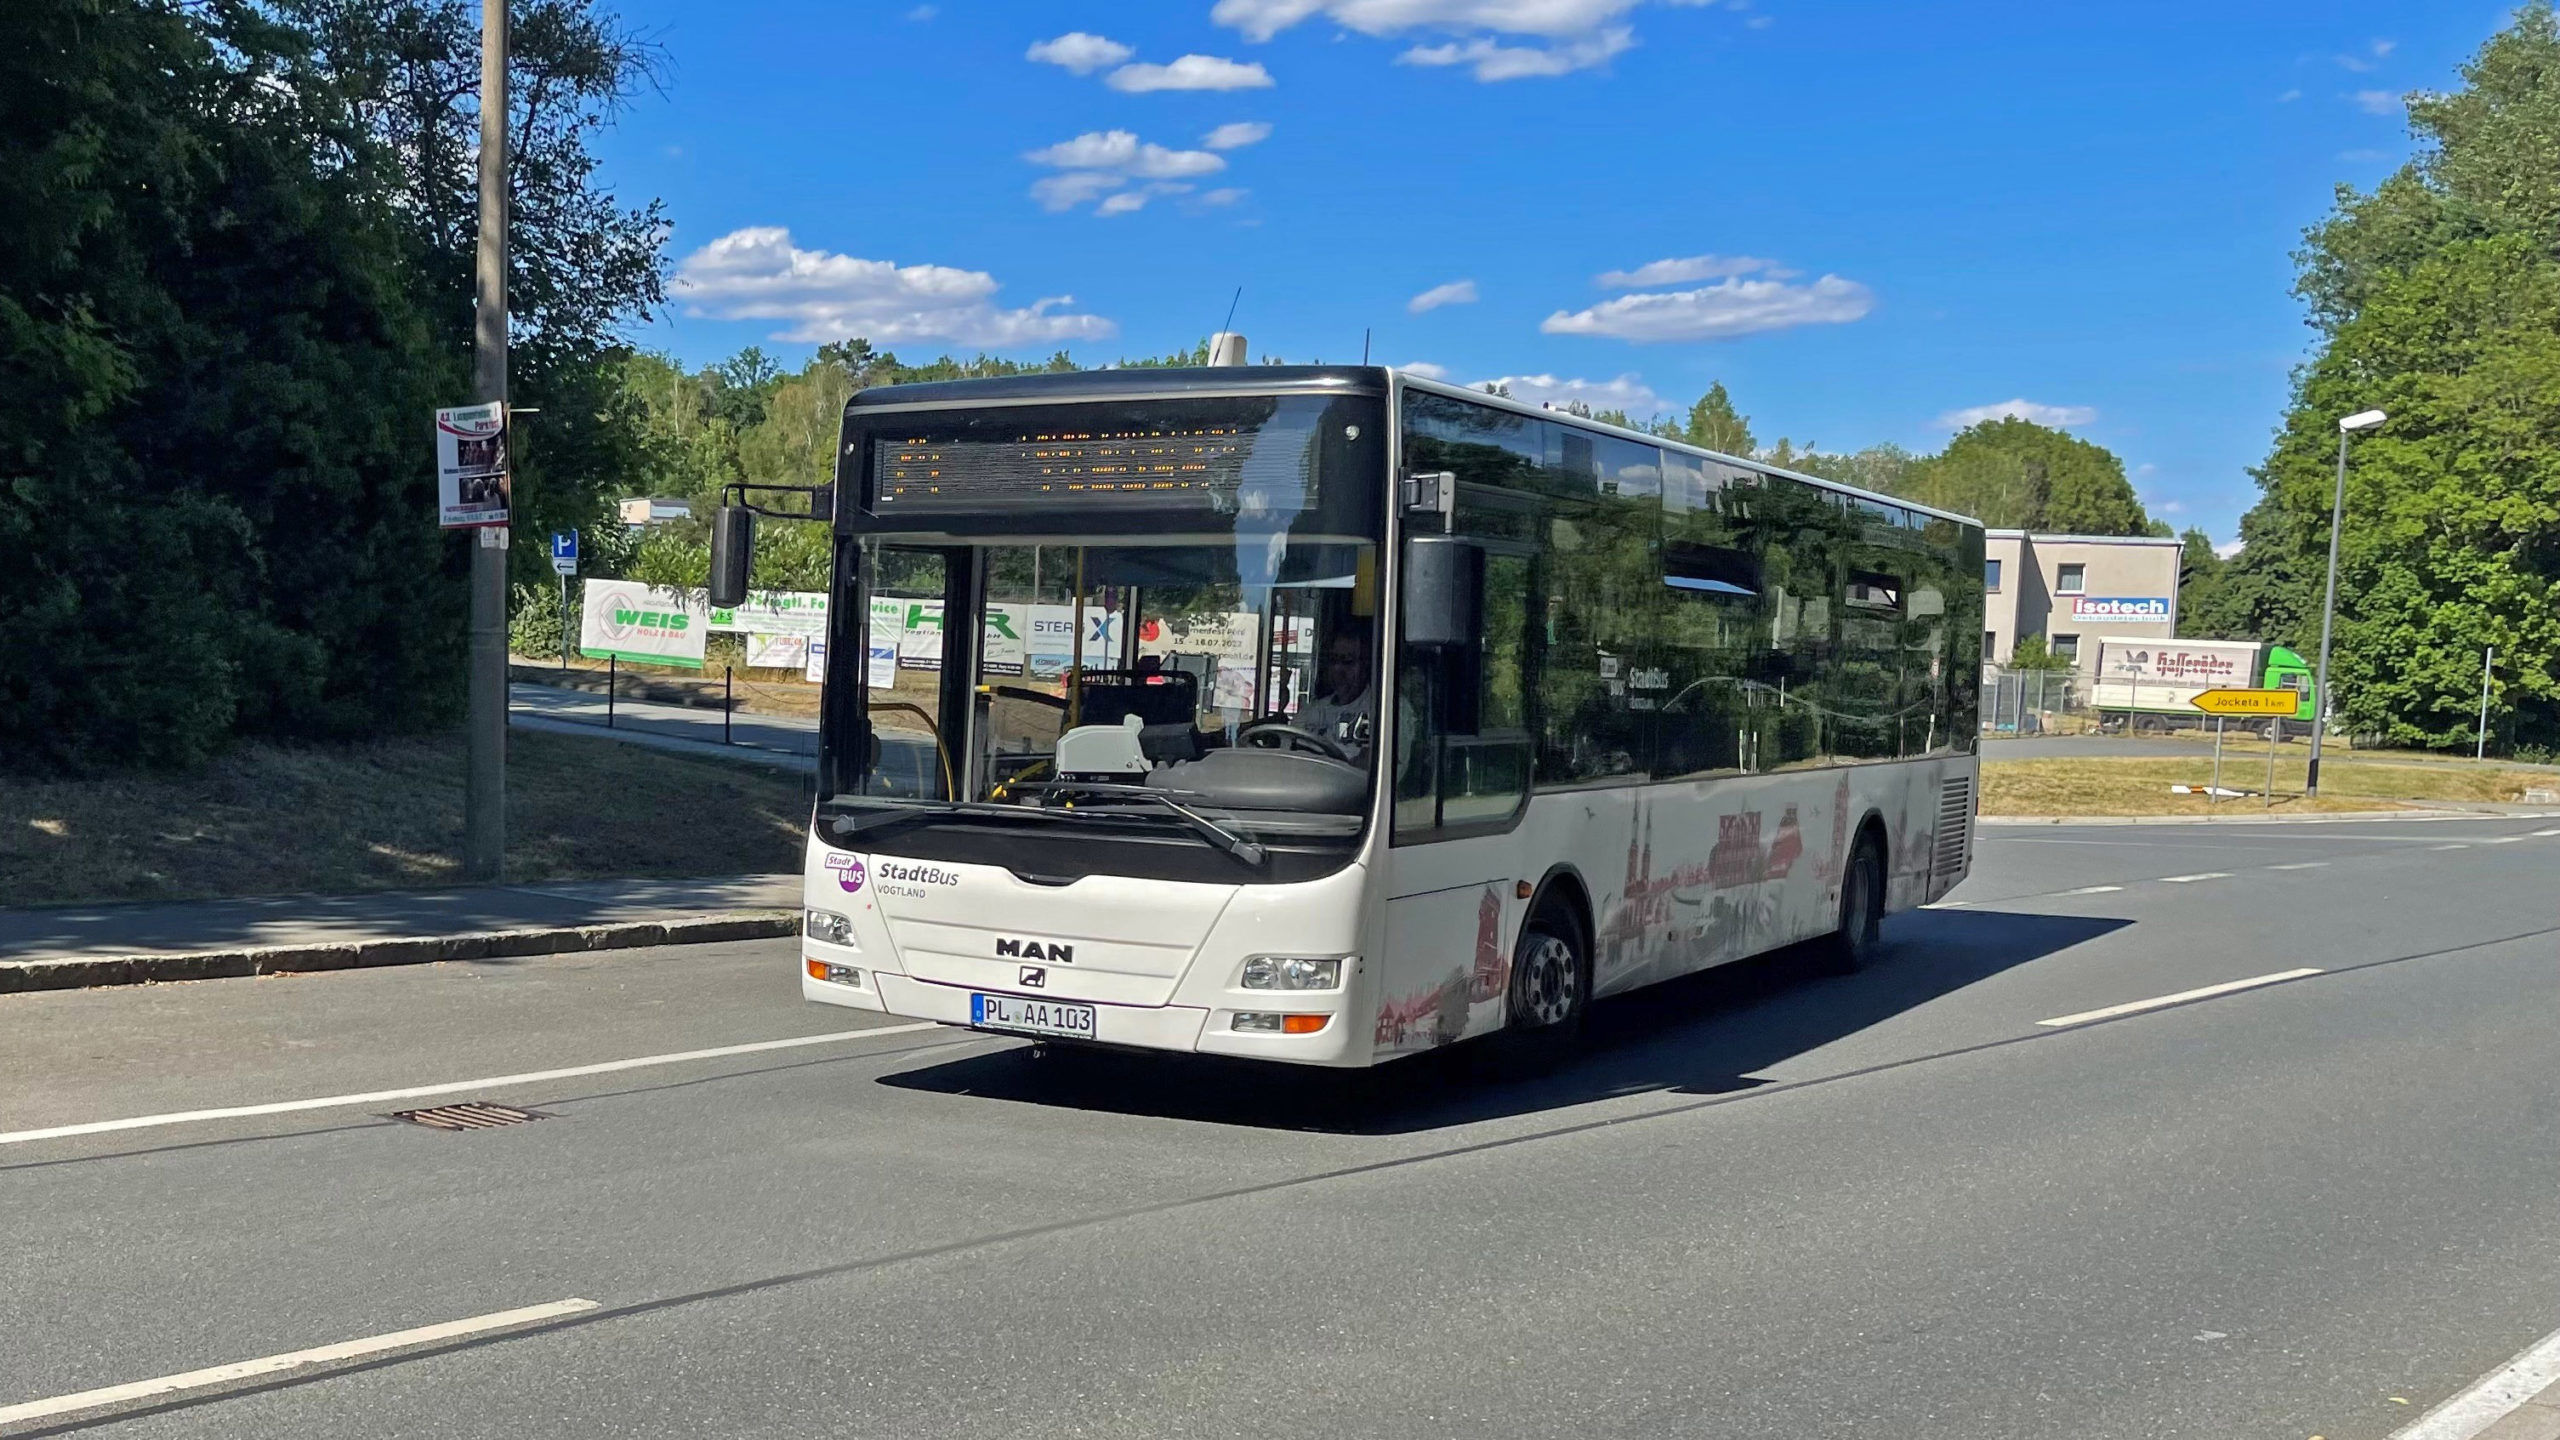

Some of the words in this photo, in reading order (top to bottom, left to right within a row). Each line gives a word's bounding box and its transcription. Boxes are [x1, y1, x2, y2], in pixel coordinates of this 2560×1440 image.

[2076, 600, 2164, 614] isotech
[615, 609, 690, 630] WEIS
[668, 631, 687, 639] BAU
[2215, 698, 2259, 707] Jocketa
[828, 856, 852, 866] Stadt
[840, 869, 864, 884] BUS
[879, 862, 960, 887] StadtBus
[877, 884, 926, 898] VOGTLAND
[996, 938, 1073, 963] MAN
[986, 999, 1010, 1022] PL
[1024, 1004, 1049, 1027] AA
[1053, 1007, 1091, 1031] 103
